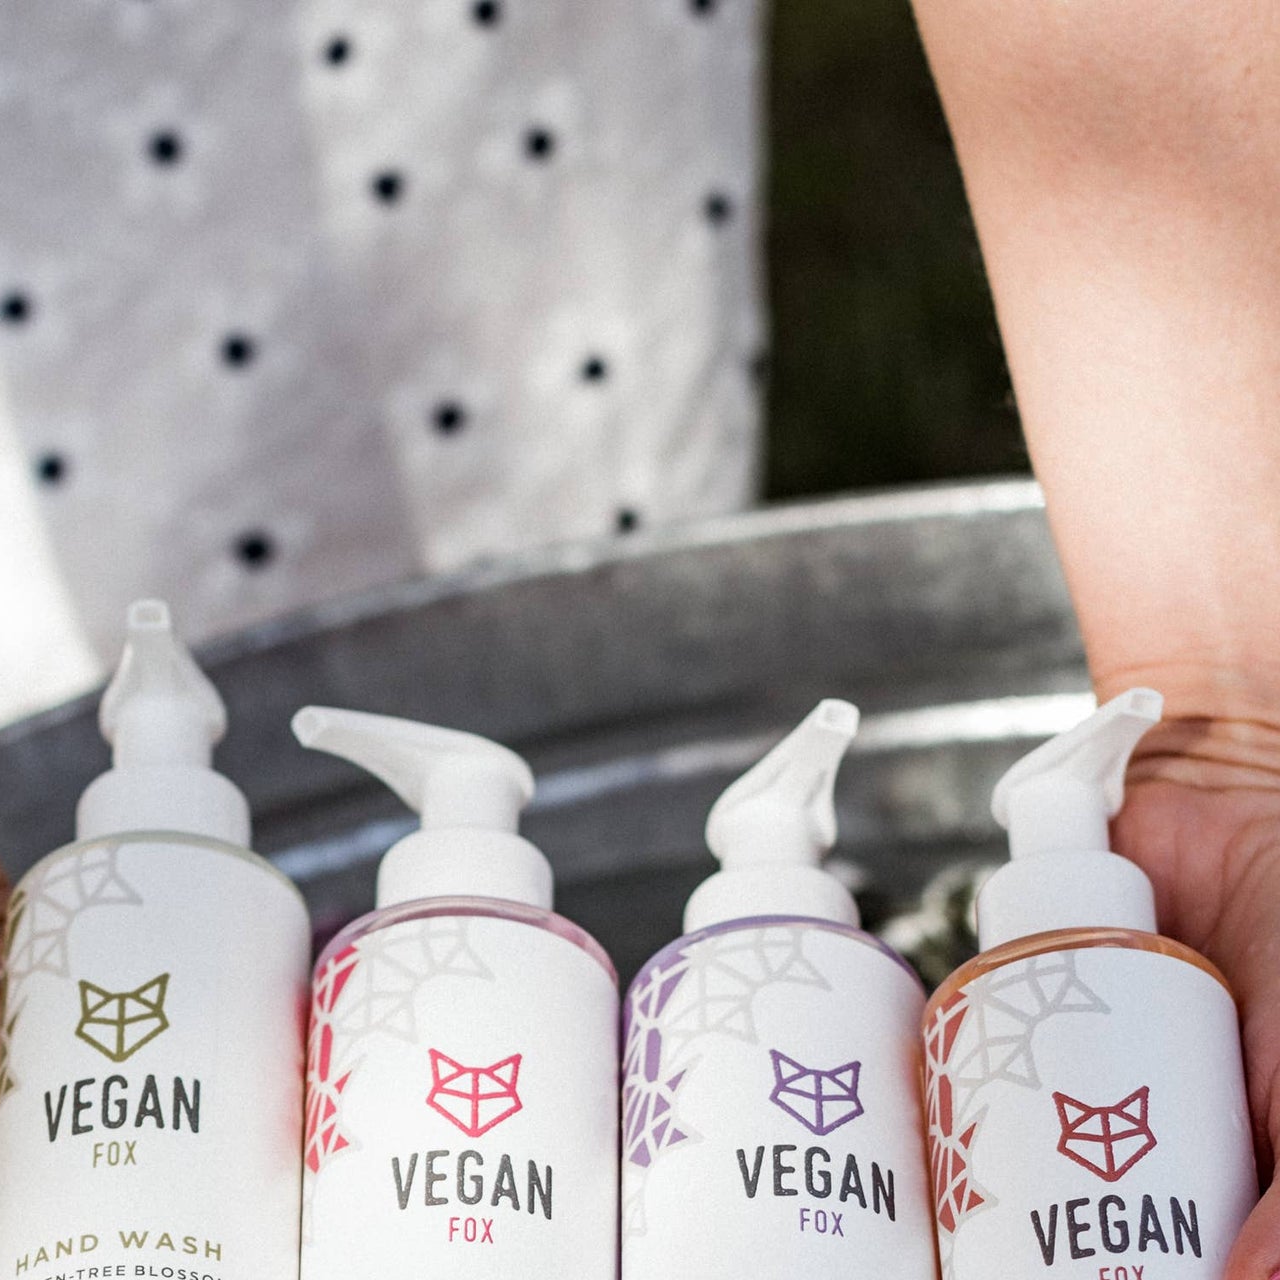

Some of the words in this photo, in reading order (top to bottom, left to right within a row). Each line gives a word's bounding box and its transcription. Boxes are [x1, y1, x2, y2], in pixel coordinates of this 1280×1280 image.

[44, 1074, 201, 1143] VEGAN
[93, 1140, 137, 1168] FOX
[391, 1150, 553, 1220] VEGAN
[736, 1144, 896, 1222] VEGAN
[448, 1216, 494, 1244] FOX
[800, 1208, 845, 1238] FOX
[1030, 1193, 1203, 1266] VEGAN
[15, 1234, 99, 1276] HAND
[118, 1230, 223, 1261] WASH
